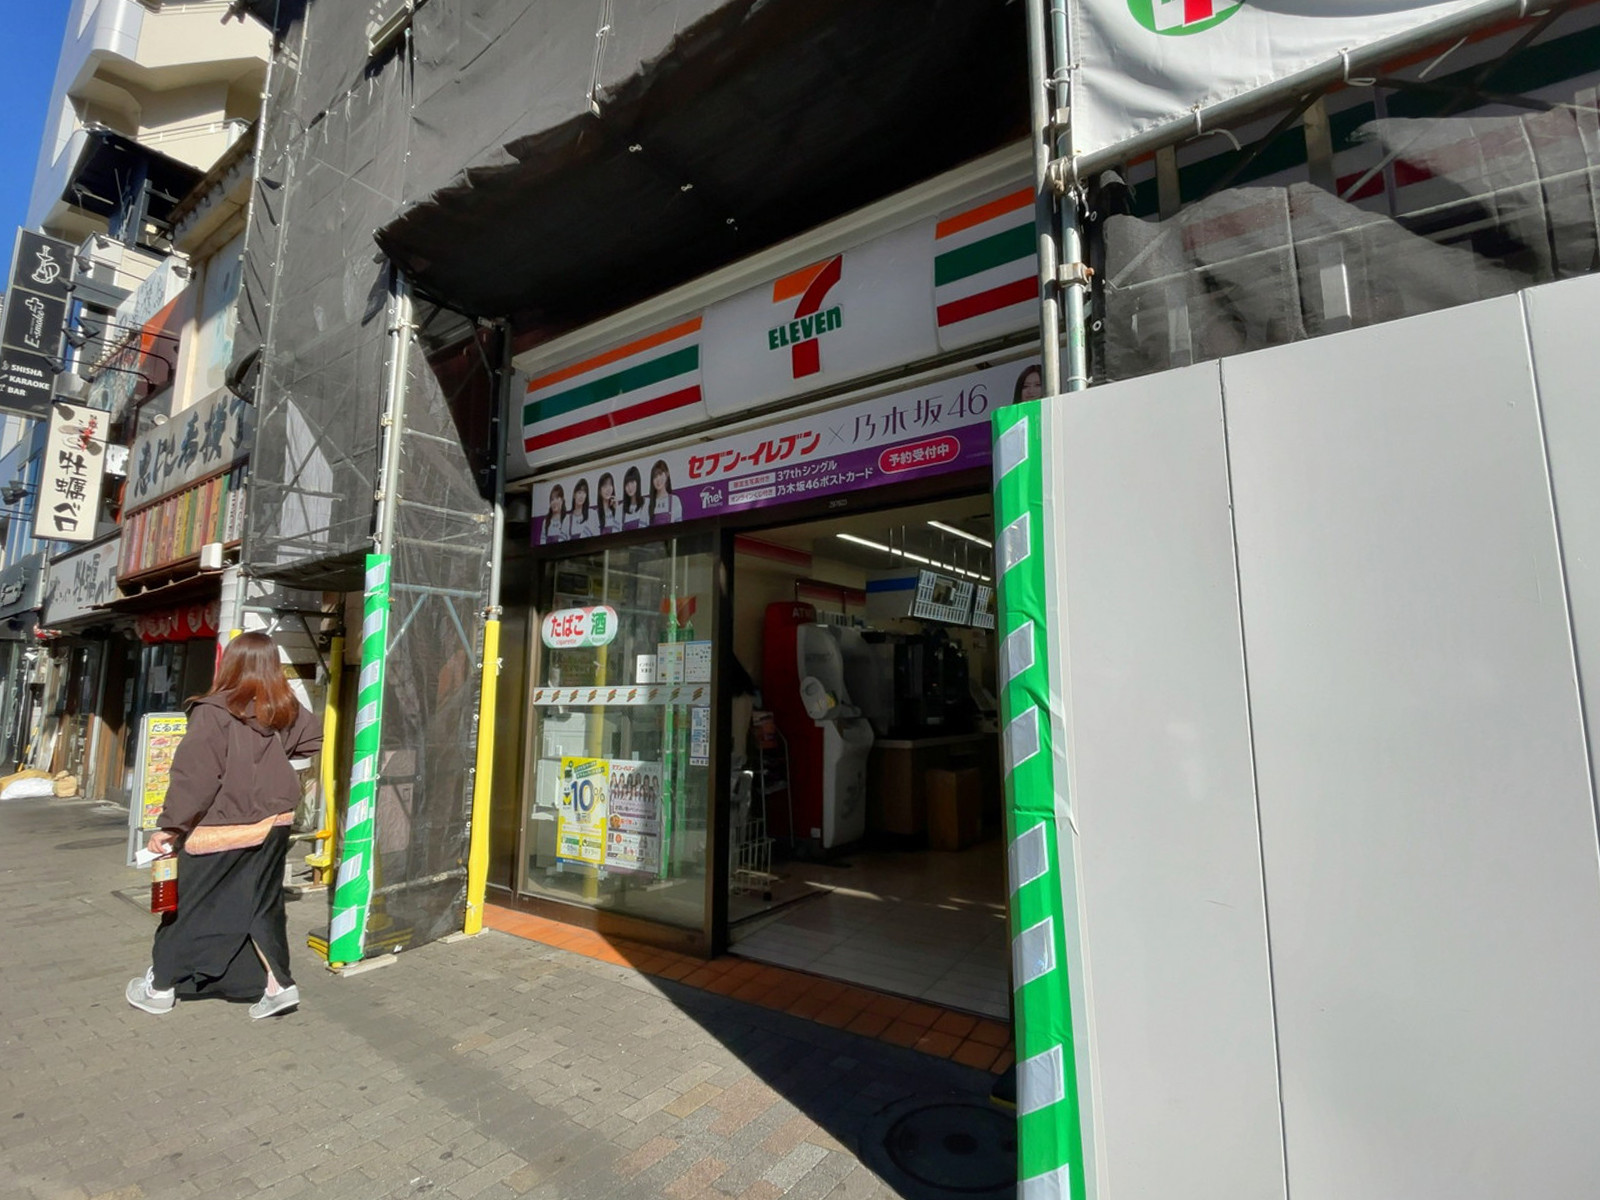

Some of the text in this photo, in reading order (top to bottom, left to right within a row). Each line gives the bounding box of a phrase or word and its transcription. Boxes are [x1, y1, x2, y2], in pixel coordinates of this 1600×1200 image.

[11, 364, 43, 377] SHISHA
[7, 386, 26, 396] BAR
[9, 375, 51, 391] KARAOKE
[852, 383, 988, 444] 乃木坂46
[134, 394, 246, 498] 恵比寿横丁
[888, 443, 950, 467] 予約受付中
[777, 460, 837, 481] 37thシングル
[777, 467, 873, 496] 乃木坂46ポストカード
[551, 612, 607, 637] たばこ 酒
